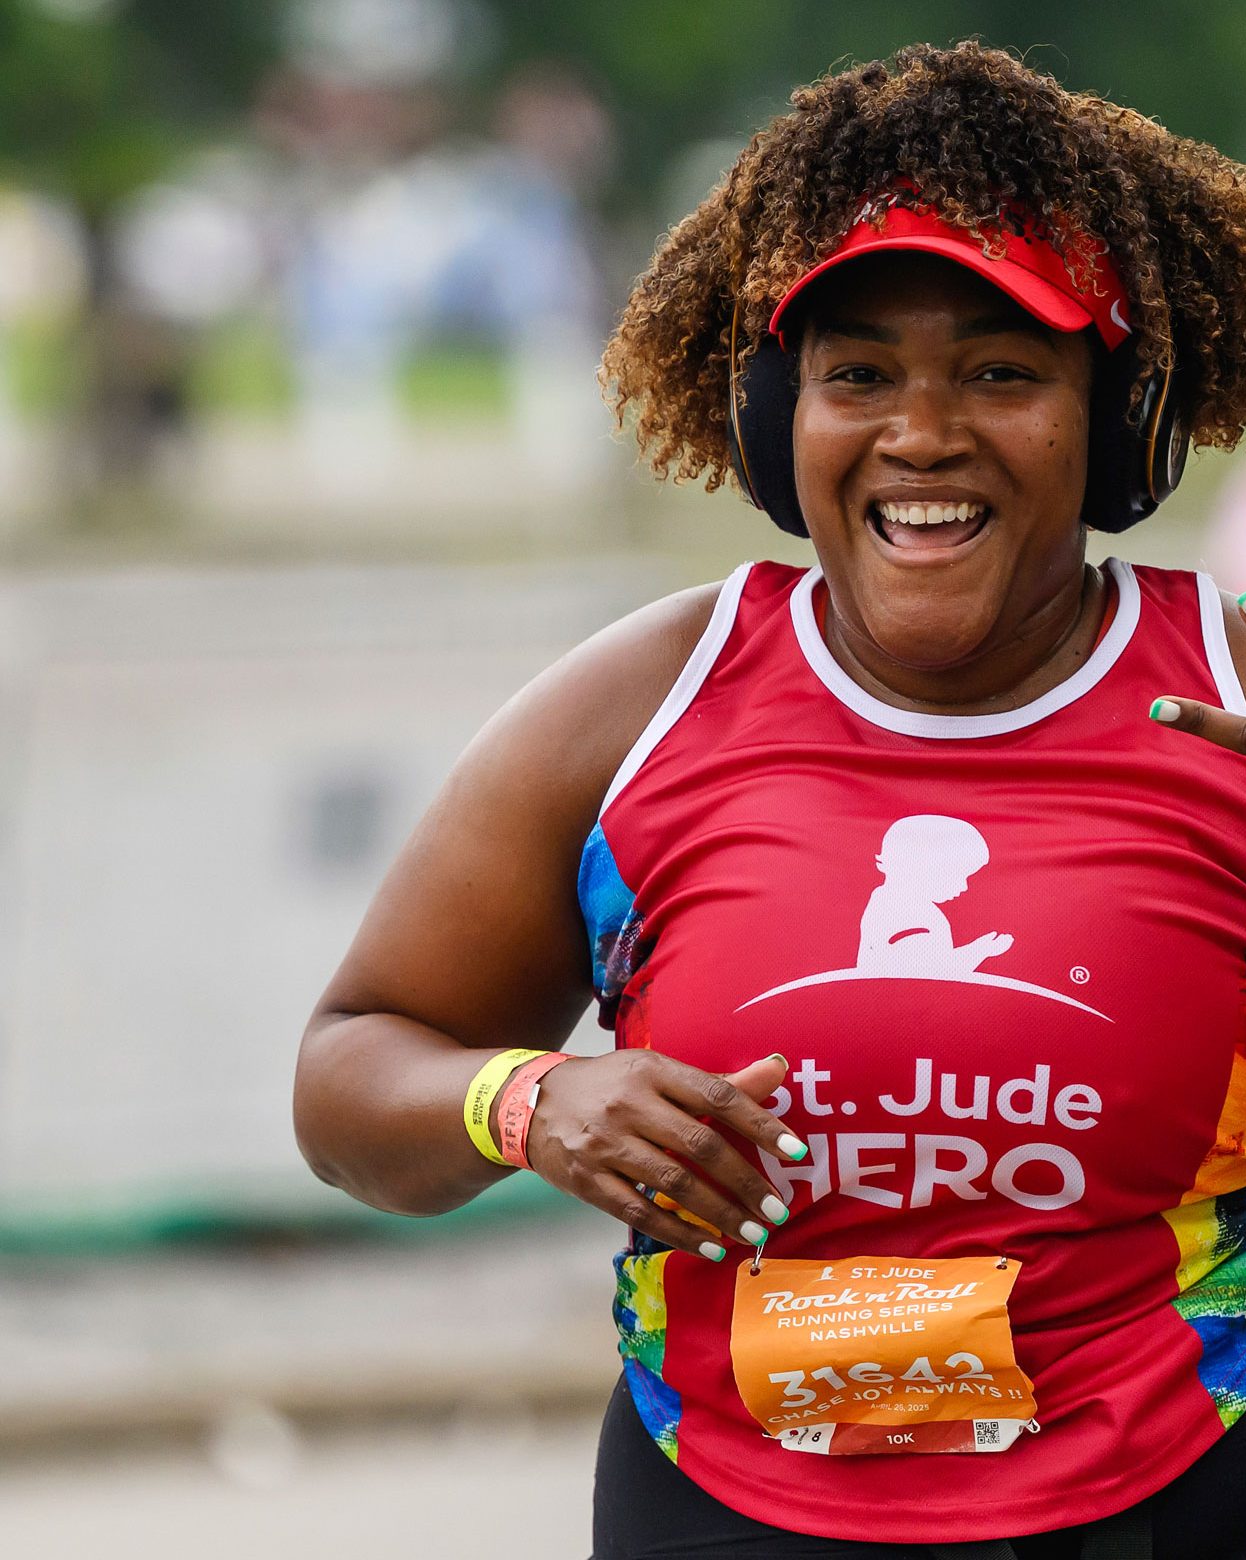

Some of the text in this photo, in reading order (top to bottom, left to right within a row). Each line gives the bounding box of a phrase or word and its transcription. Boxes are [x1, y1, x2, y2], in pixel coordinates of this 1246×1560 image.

[878, 1058, 1102, 1130] Jude
[757, 1132, 1086, 1211] HERO
[850, 1266, 936, 1280] ST. JUDE
[761, 1288, 862, 1314] Rock
[895, 1282, 979, 1301] Roll
[777, 1302, 953, 1329] RUNNING SERIES
[810, 1320, 926, 1342] NASHVILLE
[768, 1351, 994, 1408] 31642
[767, 1394, 845, 1424] CHASE
[907, 1403, 930, 1412] 2025
[886, 1432, 915, 1445] 10K
